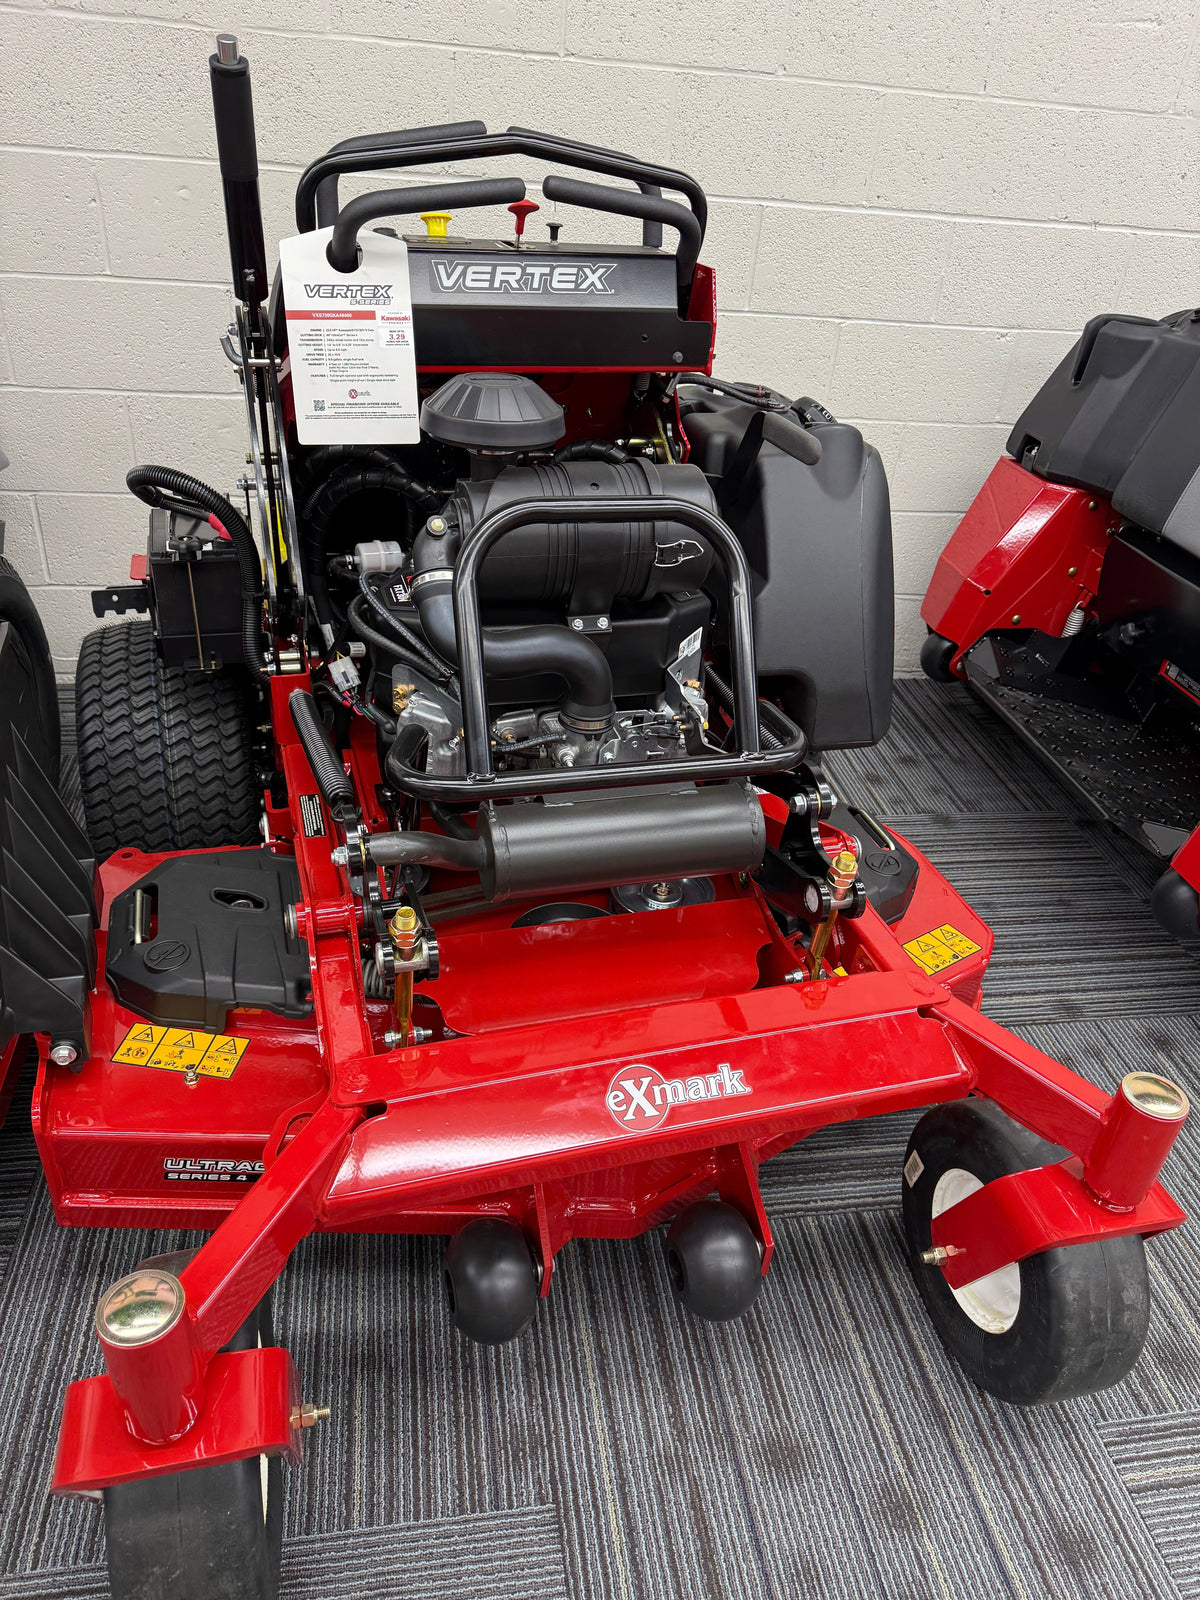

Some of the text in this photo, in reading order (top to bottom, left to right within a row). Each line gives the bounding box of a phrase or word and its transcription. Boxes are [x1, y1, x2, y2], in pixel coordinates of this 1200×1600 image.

[432, 260, 616, 293] VERTEX
[304, 284, 393, 299] VERTEX
[607, 1064, 750, 1122] eXmark
[167, 1172, 231, 1181] SERIES
